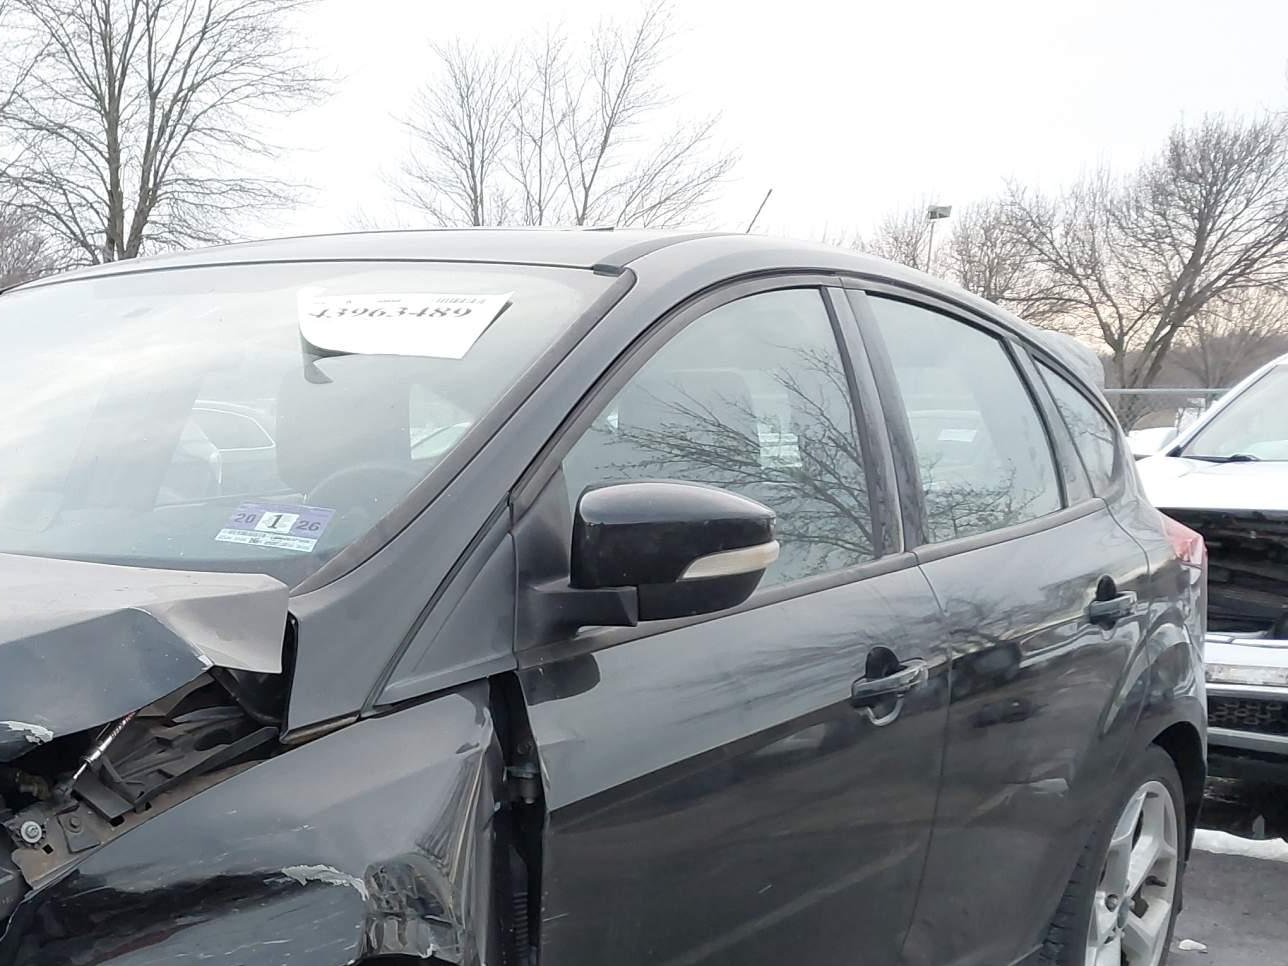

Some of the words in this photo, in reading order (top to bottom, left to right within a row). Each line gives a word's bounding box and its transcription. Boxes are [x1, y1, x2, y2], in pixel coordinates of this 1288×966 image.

[233, 512, 258, 524] 20
[267, 513, 284, 530] 1
[296, 519, 322, 532] 26
